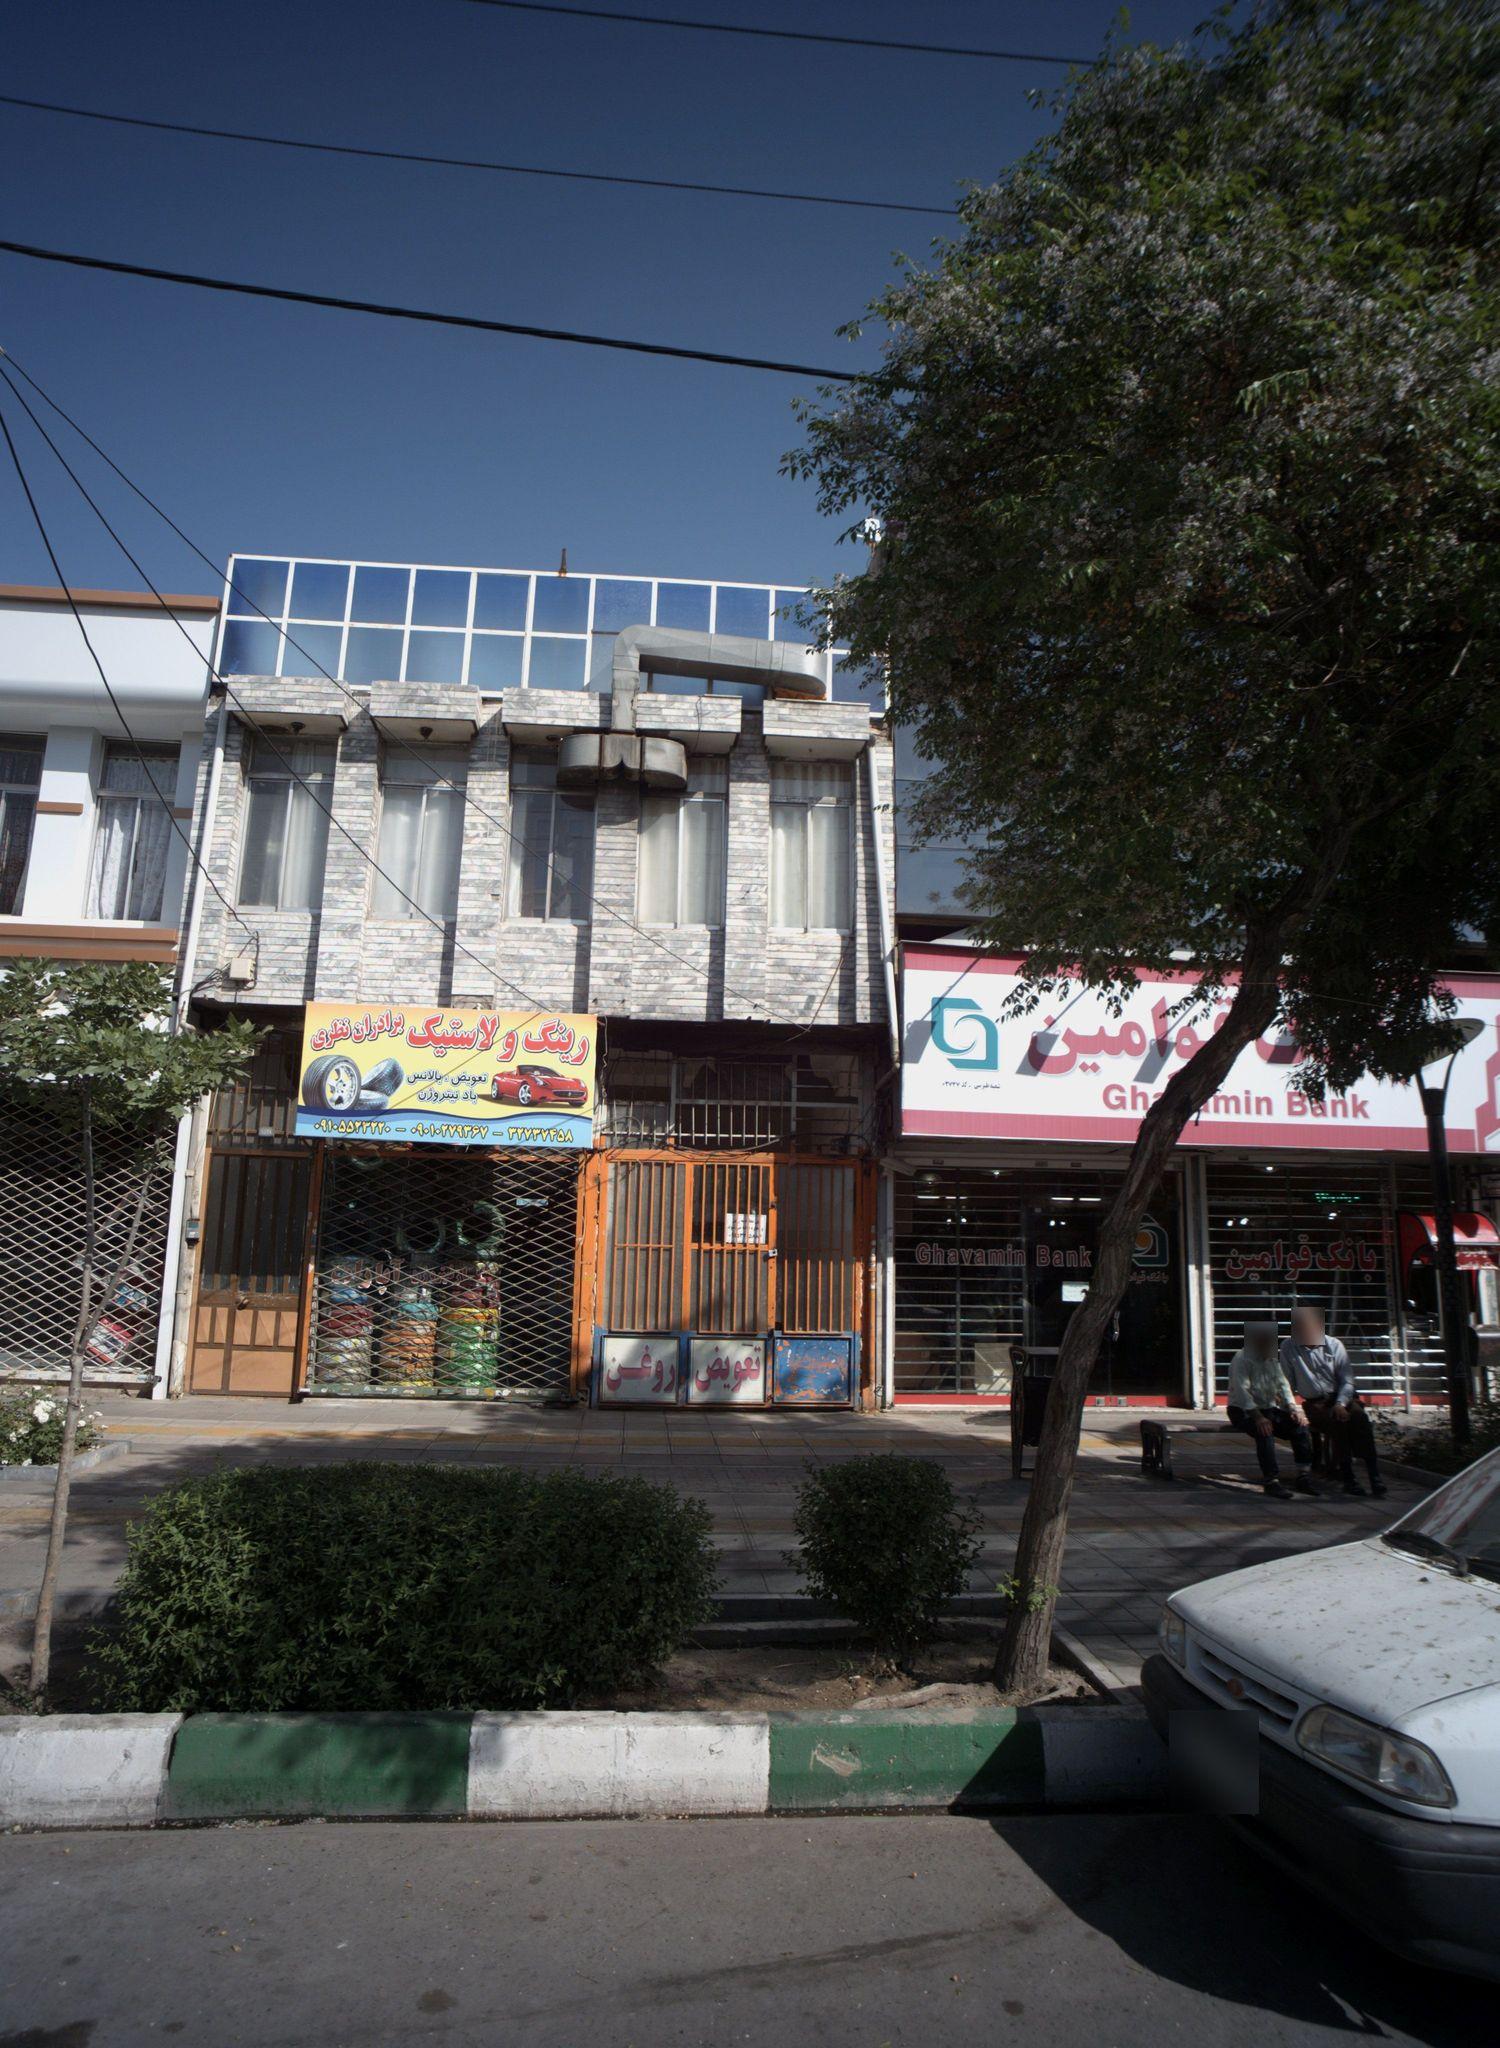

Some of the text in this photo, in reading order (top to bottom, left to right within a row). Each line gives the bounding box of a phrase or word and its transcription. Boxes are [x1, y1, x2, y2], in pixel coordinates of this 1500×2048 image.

[310, 1010, 589, 1064] رینگ و لاستیک برادران نظری
[407, 1070, 487, 1086] تعویض بالانس
[417, 1087, 477, 1104] باد نیتروژن
[1103, 1083, 1370, 1119] Ghmin Bank
[915, 1242, 1092, 1267] Ghavamin Bank
[1226, 1234, 1377, 1281] بانک قوامین
[606, 1345, 676, 1392] روغن
[695, 1346, 761, 1392] تعویض
